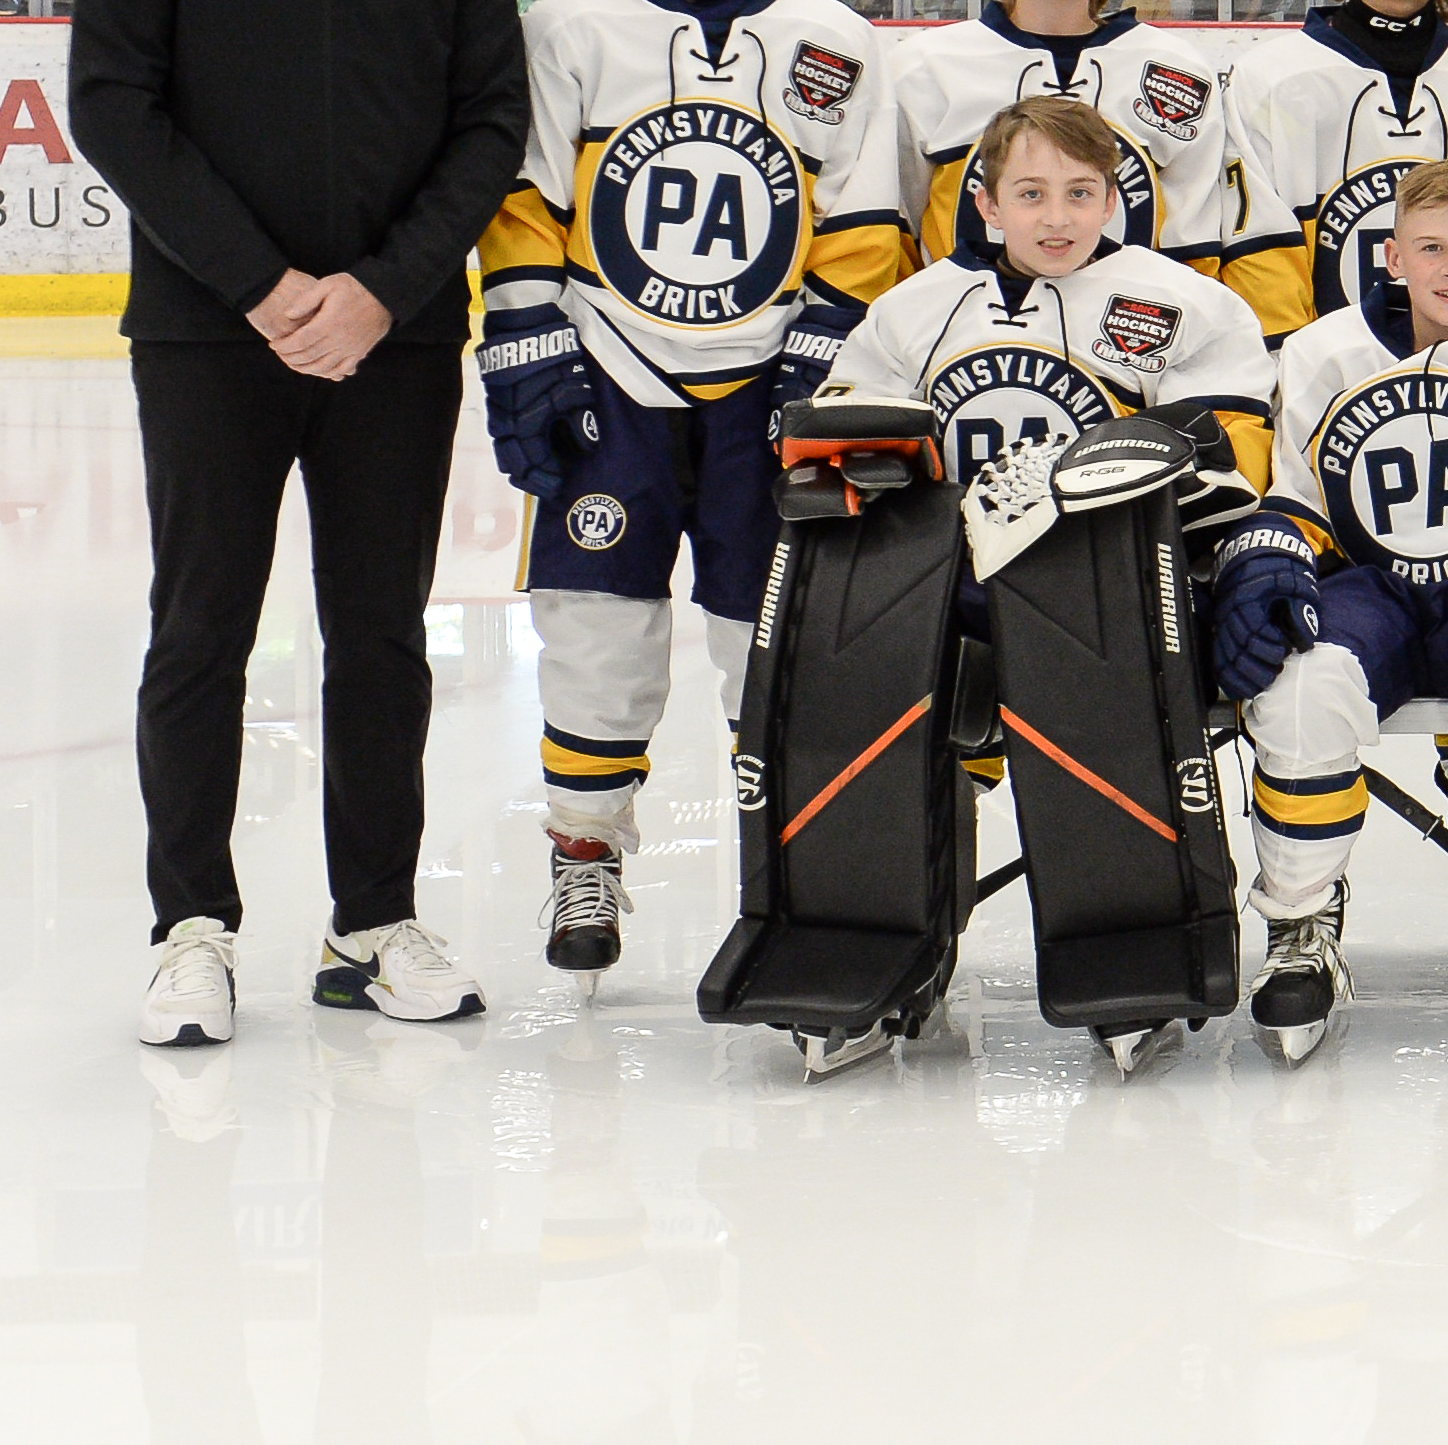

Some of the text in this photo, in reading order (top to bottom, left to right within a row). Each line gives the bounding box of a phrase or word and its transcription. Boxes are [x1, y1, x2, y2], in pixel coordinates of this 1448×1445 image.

[794, 62, 851, 92] HOCKEY
[1145, 78, 1202, 110] HOCKEY
[603, 109, 796, 207] PENNSYLVANIA
[640, 164, 748, 261] PA
[1226, 158, 1251, 236] 7
[638, 278, 742, 319] BRICK
[1107, 314, 1171, 340] HOCKEY
[1074, 439, 1171, 459] WARRIOR
[581, 509, 609, 533] PA
[756, 541, 790, 649] WARRIOR
[1158, 542, 1180, 654] WARRIOR
